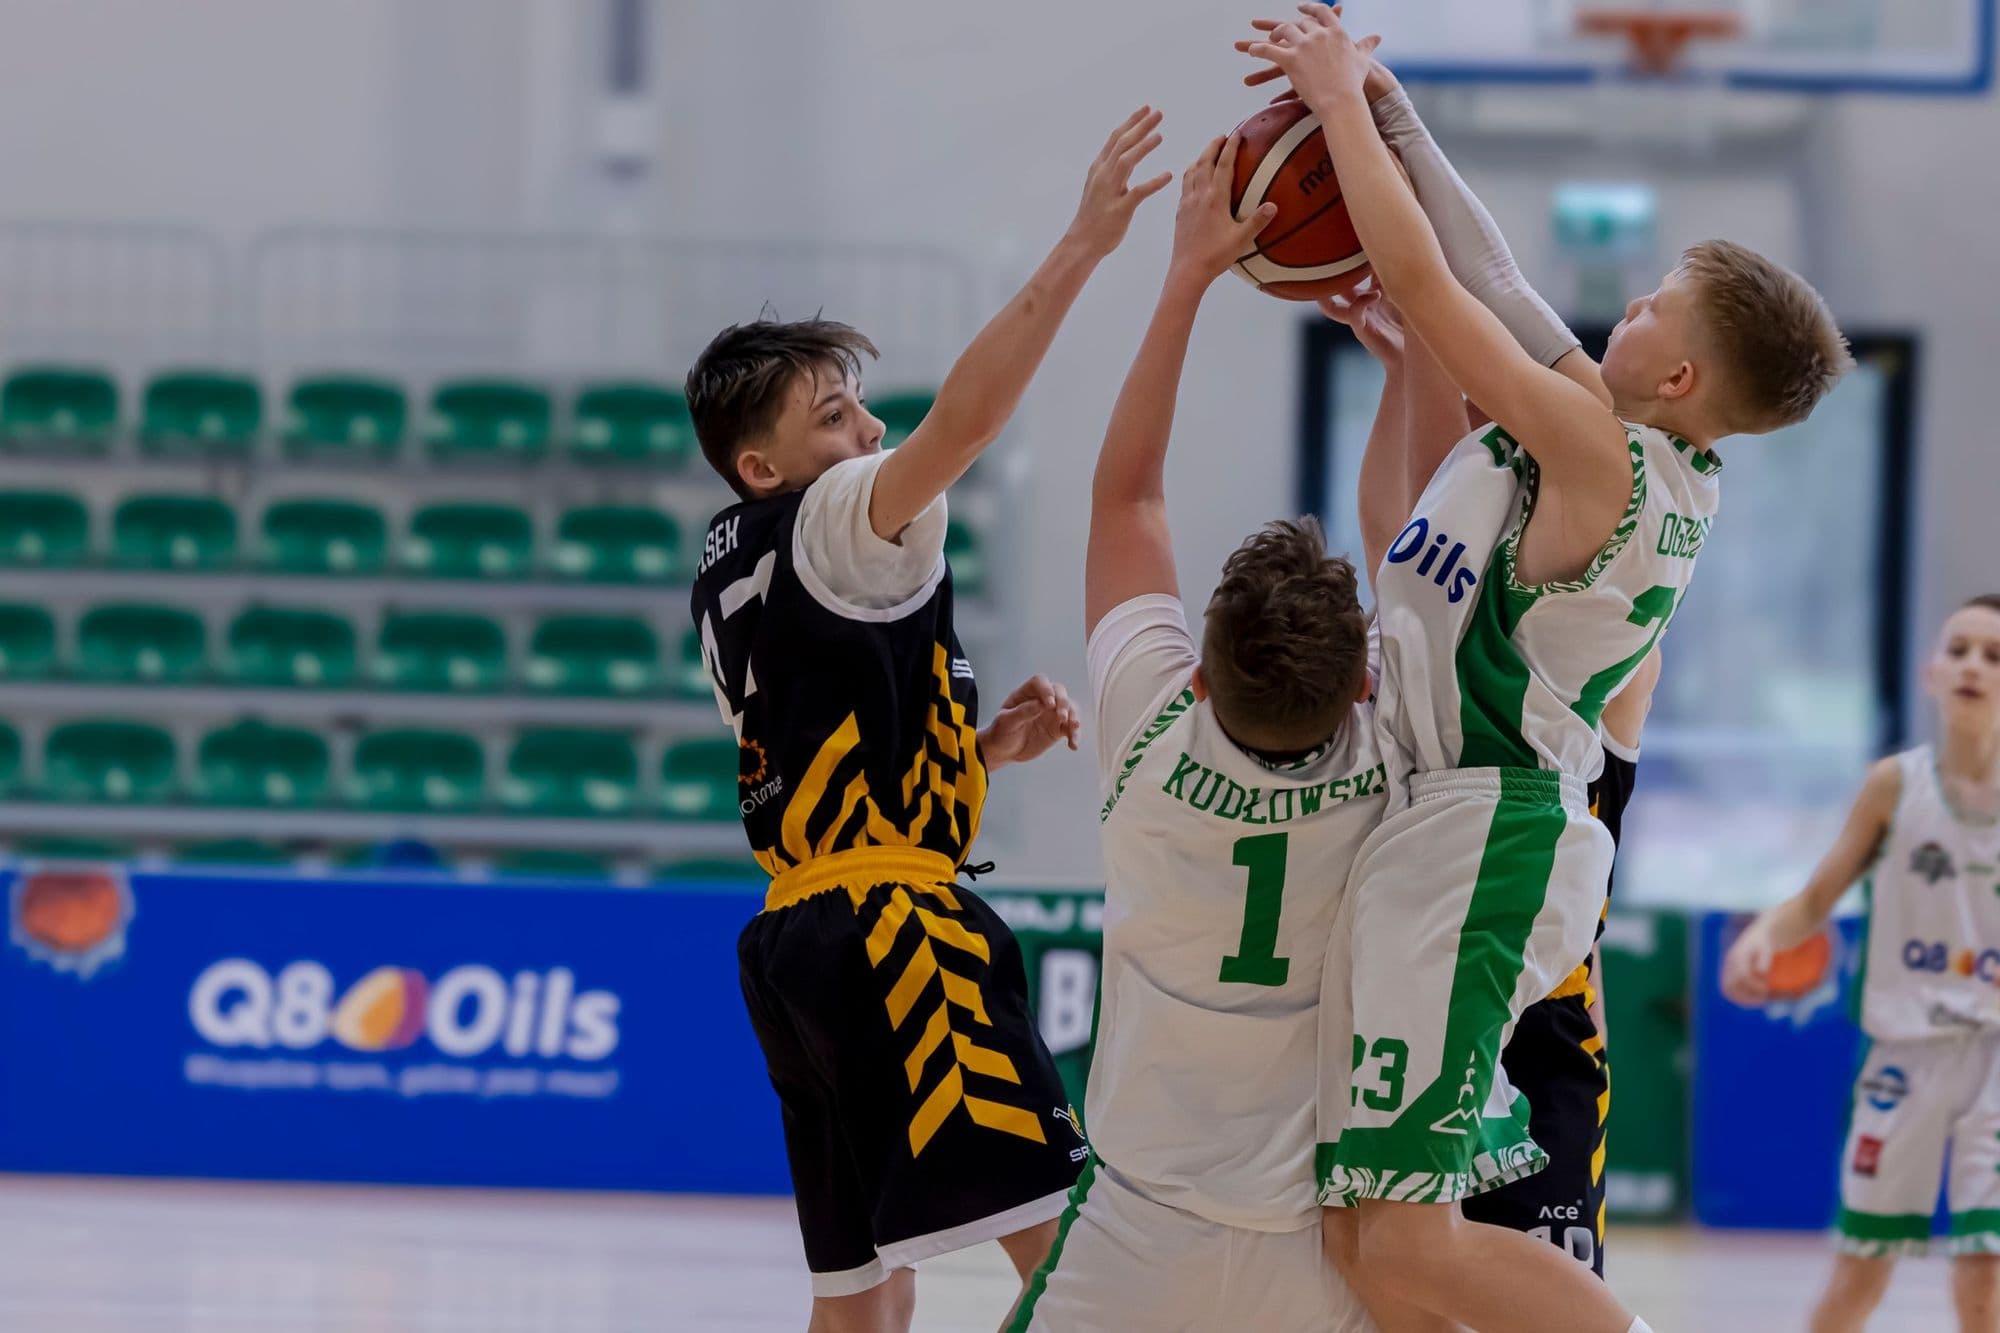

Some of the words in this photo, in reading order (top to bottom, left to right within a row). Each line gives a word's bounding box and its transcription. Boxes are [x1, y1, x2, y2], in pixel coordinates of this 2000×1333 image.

[1387, 517, 1477, 604] Oils
[1218, 831, 1291, 987] 1
[190, 958, 335, 1050] Q8
[427, 963, 622, 1061] Oils
